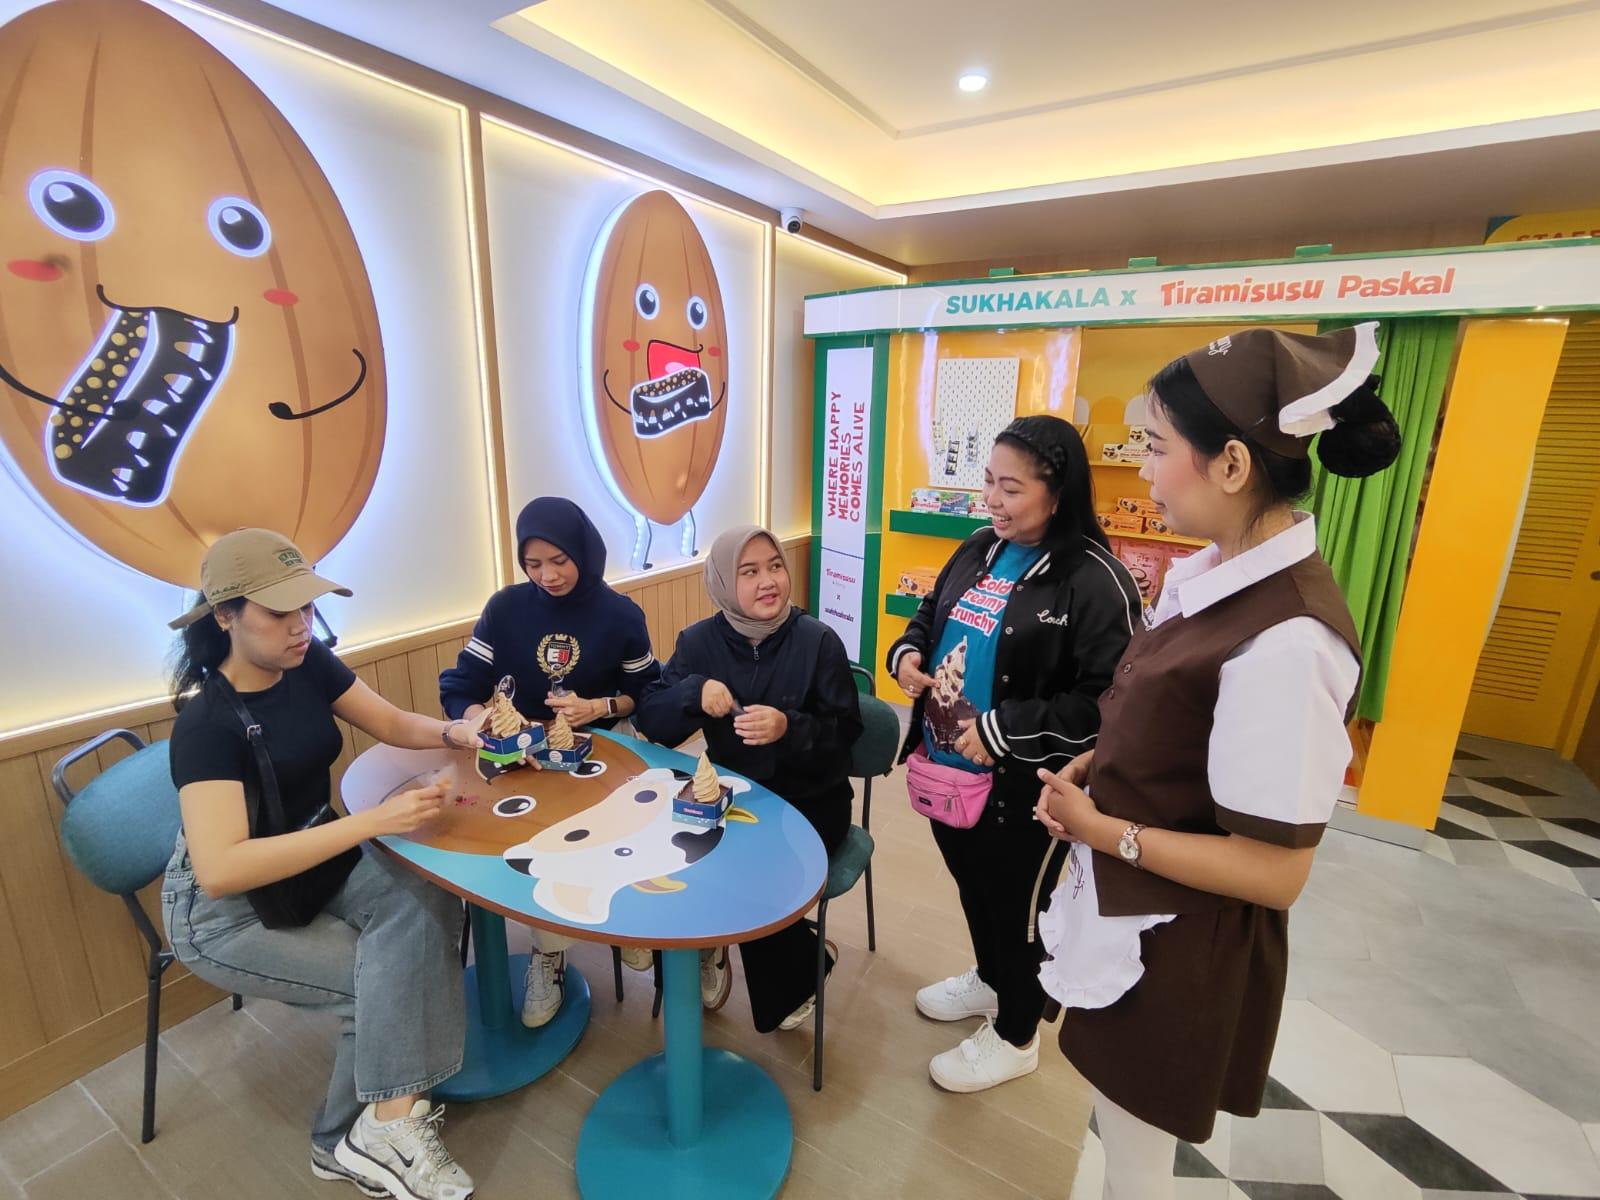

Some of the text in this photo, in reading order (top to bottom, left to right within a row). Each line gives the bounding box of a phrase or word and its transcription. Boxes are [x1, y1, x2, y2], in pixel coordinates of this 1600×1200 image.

[946, 287, 1110, 314] SUKHAKALA
[1161, 278, 1324, 306] Tiramisusu
[1337, 267, 1456, 299] Paskal
[827, 391, 842, 517] WHERE HAPPY
[838, 432, 851, 521] MEMORIES
[850, 402, 865, 523] COMES ALIVE
[961, 590, 1006, 613] reamy
[977, 575, 1013, 595] Cold
